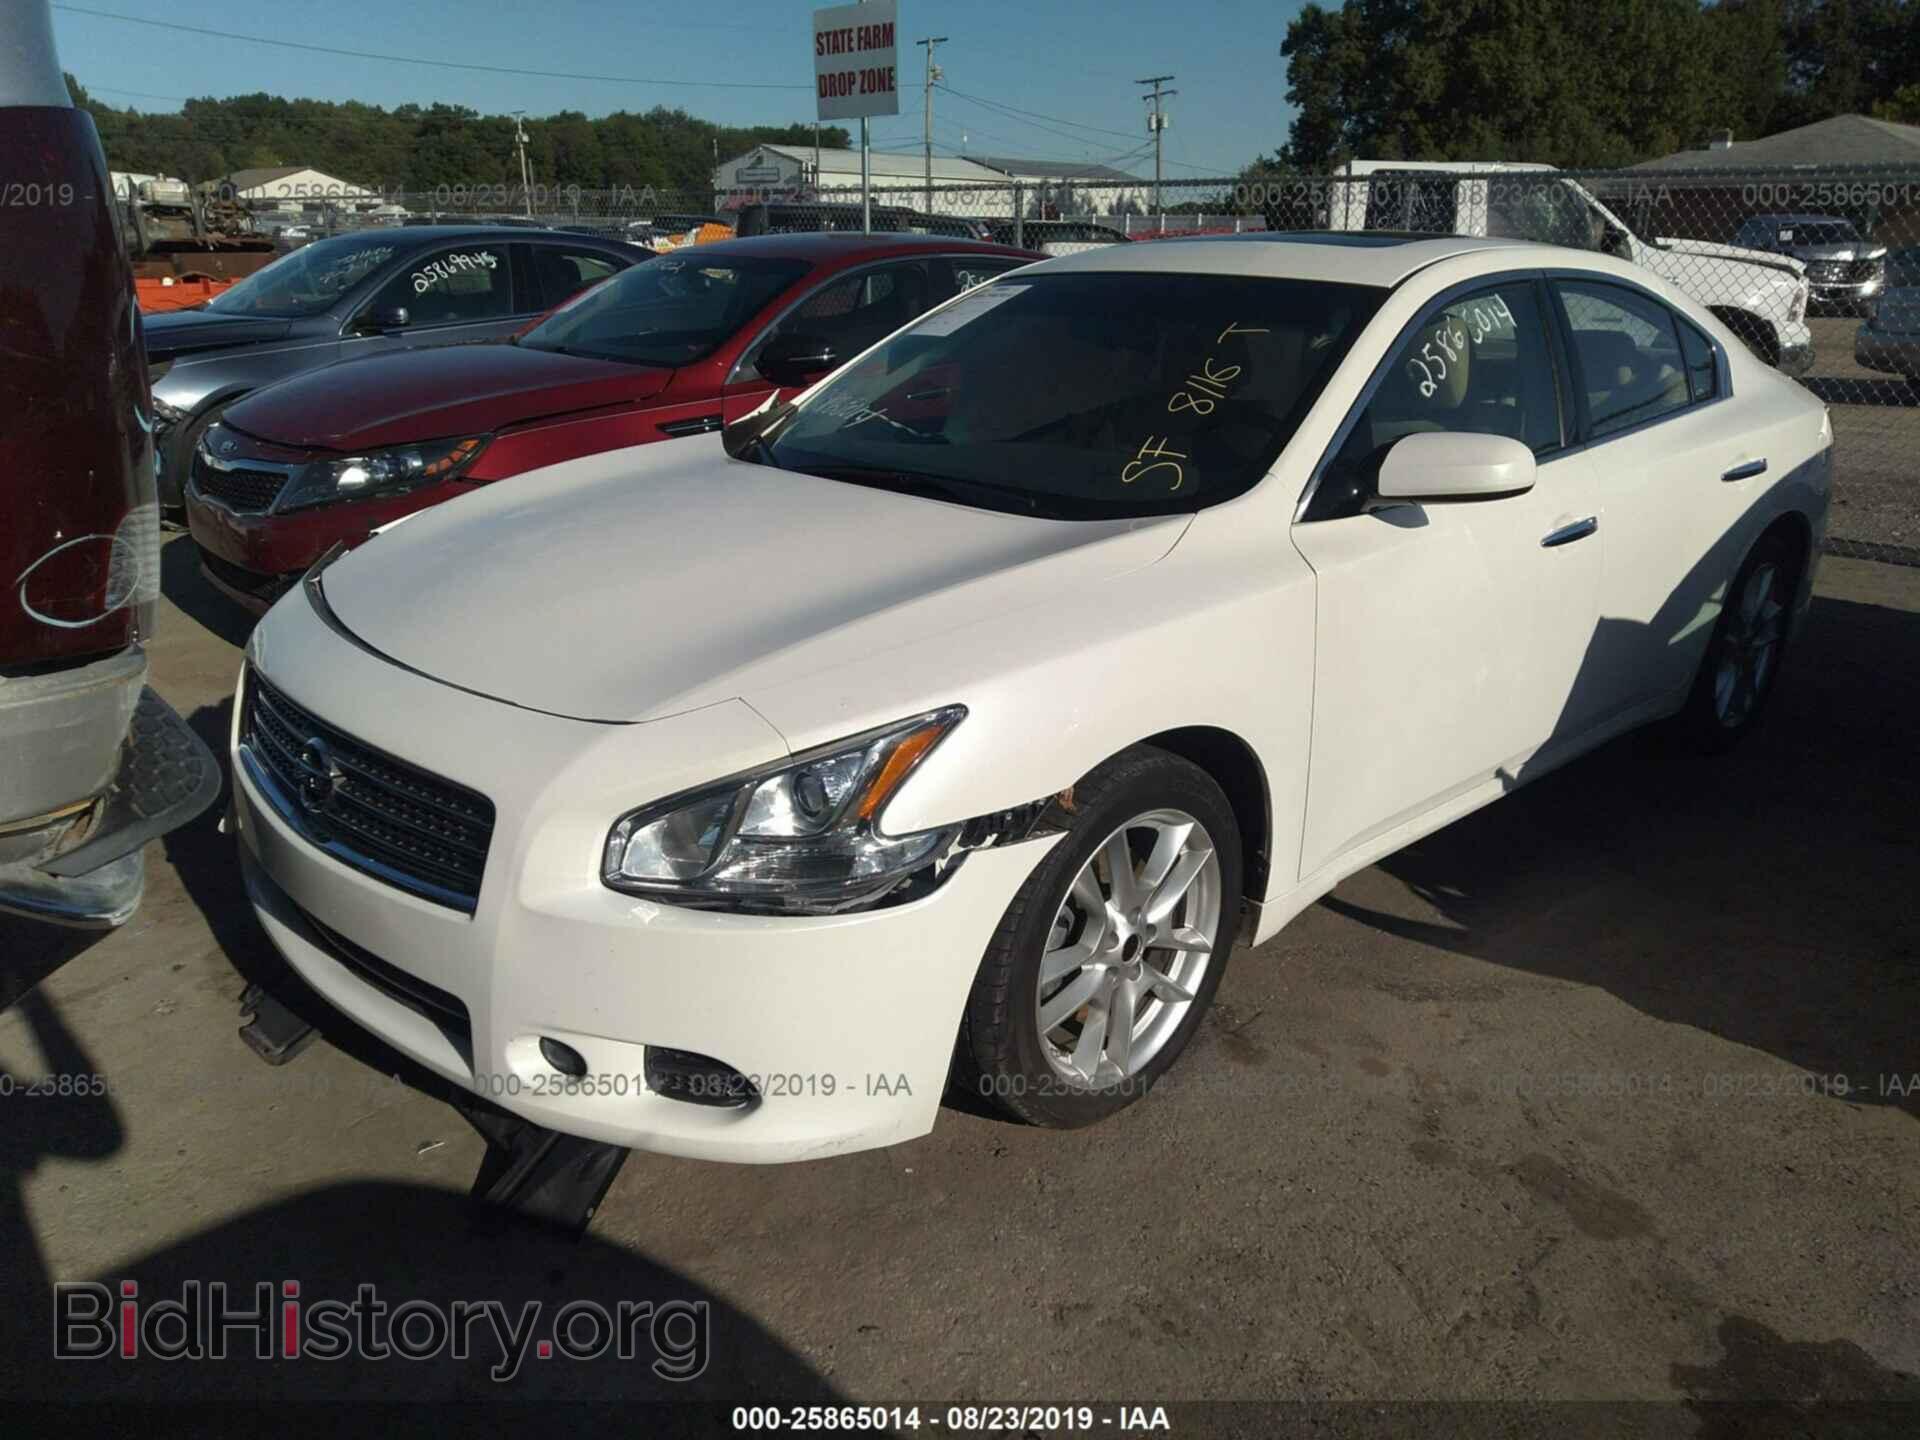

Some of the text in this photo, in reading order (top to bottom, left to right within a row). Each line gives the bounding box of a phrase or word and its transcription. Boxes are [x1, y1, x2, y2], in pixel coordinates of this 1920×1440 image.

[816, 22, 894, 56] STATE FARM
[818, 66, 895, 98] DROP ZONE
